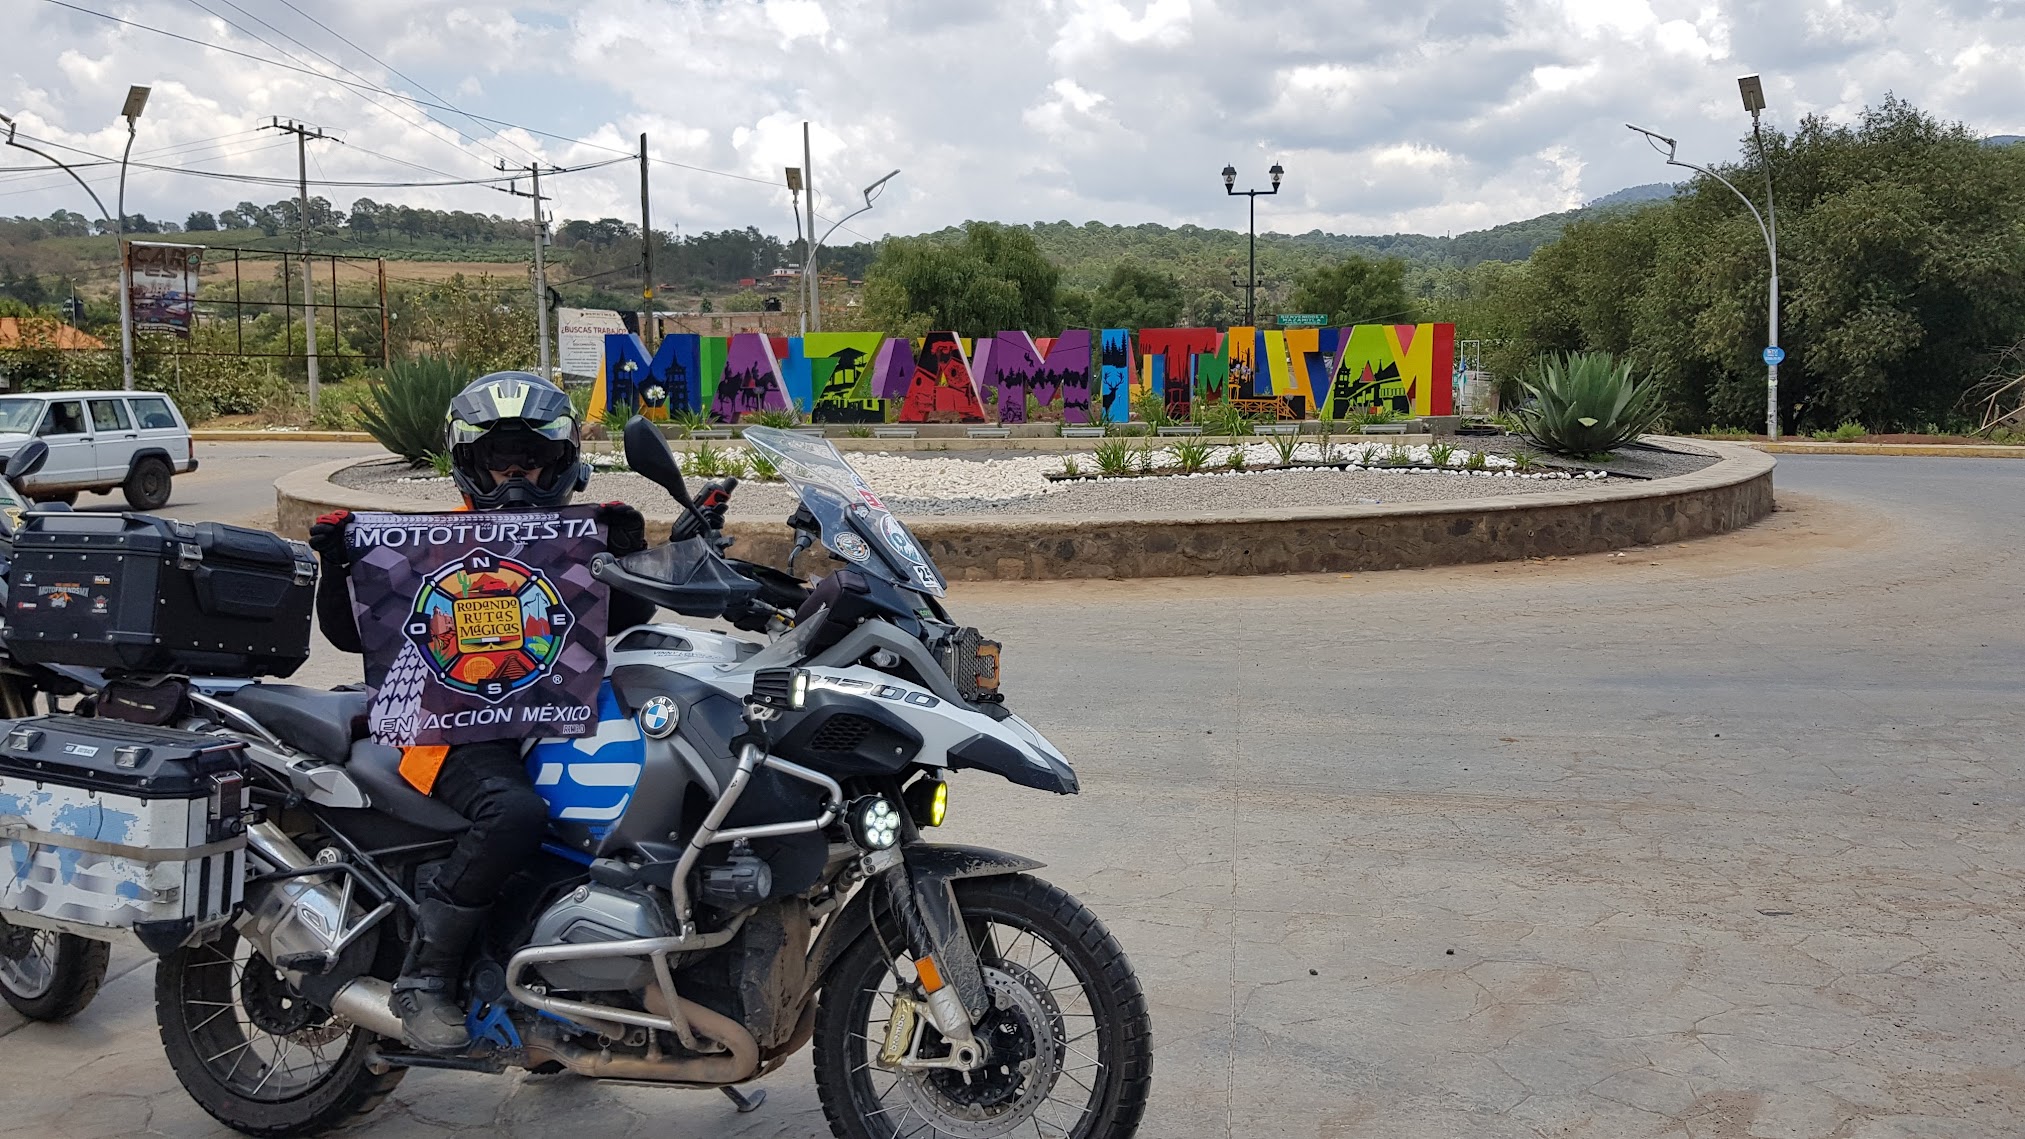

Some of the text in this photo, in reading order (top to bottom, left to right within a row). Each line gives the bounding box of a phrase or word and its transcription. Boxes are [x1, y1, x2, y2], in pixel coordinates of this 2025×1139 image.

[561, 325, 592, 334] ¿BUSCAS
[604, 324, 1416, 424] MAZAMITLA
[354, 518, 599, 548] MOTOTURISTA
[473, 556, 490, 568] N
[553, 614, 566, 625] E
[410, 623, 426, 635] O
[487, 683, 502, 695] S
[380, 703, 591, 732] EN ACCIÓN MÉXICO
[890, 1014, 905, 1051] brembo
